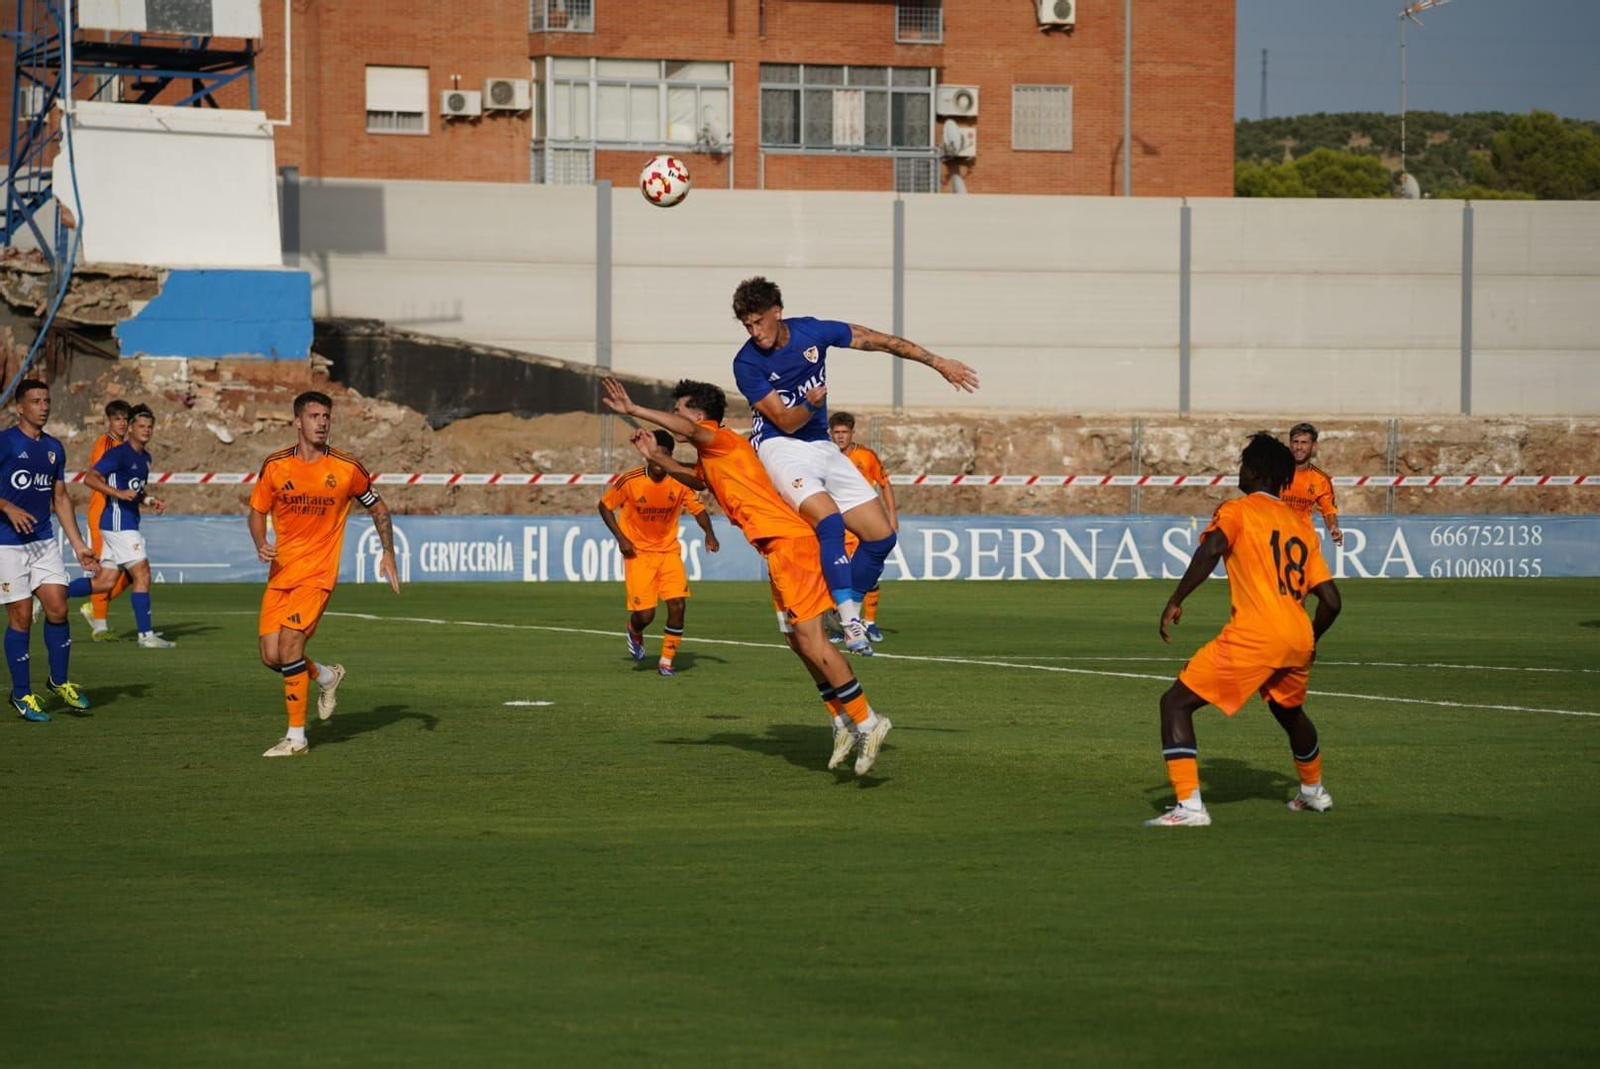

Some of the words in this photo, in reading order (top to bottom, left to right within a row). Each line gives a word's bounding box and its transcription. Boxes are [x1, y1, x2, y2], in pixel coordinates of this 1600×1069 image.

[420, 535, 514, 572] CERVECERÍA
[523, 526, 548, 582] El
[1430, 525, 1543, 546] 666752138
[1270, 530, 1308, 600] 18
[1430, 558, 1542, 578] 610080155
